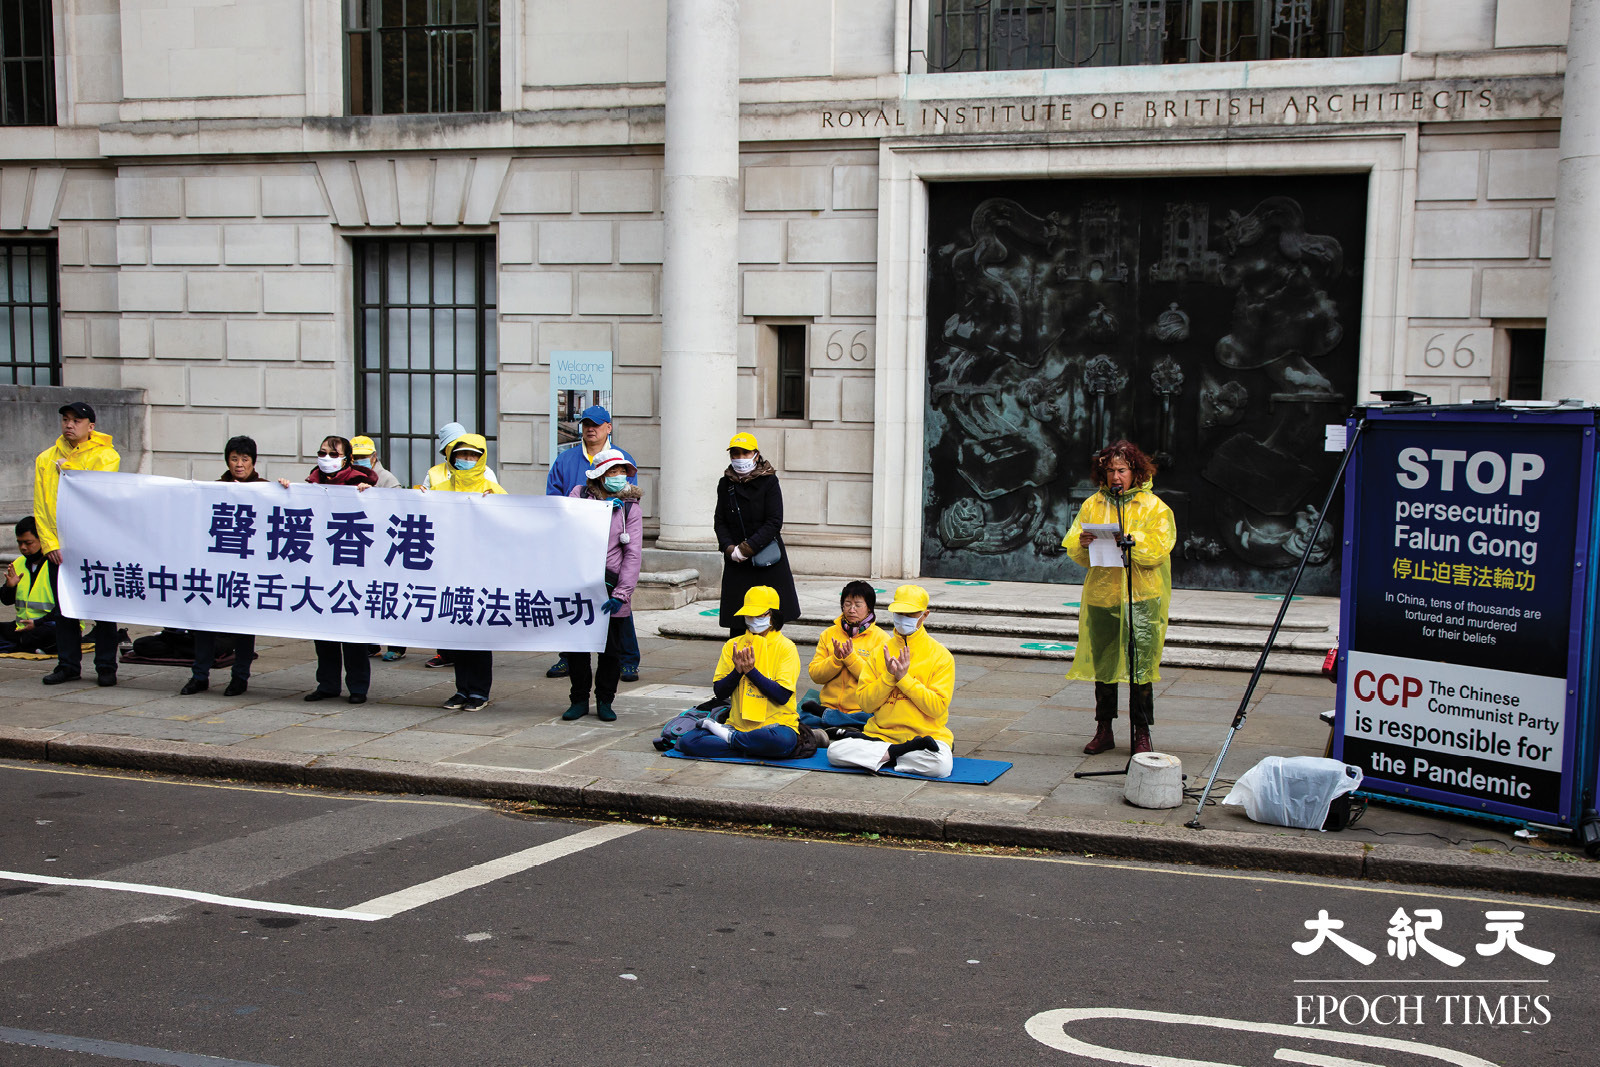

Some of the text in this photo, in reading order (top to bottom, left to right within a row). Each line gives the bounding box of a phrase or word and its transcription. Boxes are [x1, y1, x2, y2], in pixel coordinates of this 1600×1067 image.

[822, 89, 1492, 128] ROYAL INSTITUTE OF BRITISH ARCHITECTS
[826, 329, 868, 362] 66
[1424, 333, 1475, 368] 66
[557, 360, 605, 372] Welcome
[557, 374, 594, 385] to RIBA
[1396, 447, 1545, 496] STOP
[1395, 500, 1540, 533] persecuting
[207, 502, 435, 570] 聲援香港
[1394, 525, 1538, 565] Falun Gong
[1392, 557, 1536, 592] 停止迫害法輪功
[80, 558, 595, 628] 抗議中共喉舌大公報污衊法輪功
[1385, 592, 1542, 619] In China, tens of thousands are
[1405, 609, 1517, 632] tortured and murdered
[1422, 626, 1496, 645] for their beliefs
[1353, 669, 1423, 708] CCP
[1429, 680, 1520, 706] The Chinese
[1428, 698, 1559, 735] Communist Party
[1355, 710, 1552, 762] is responsible for
[1371, 752, 1532, 799] the Pandemic
